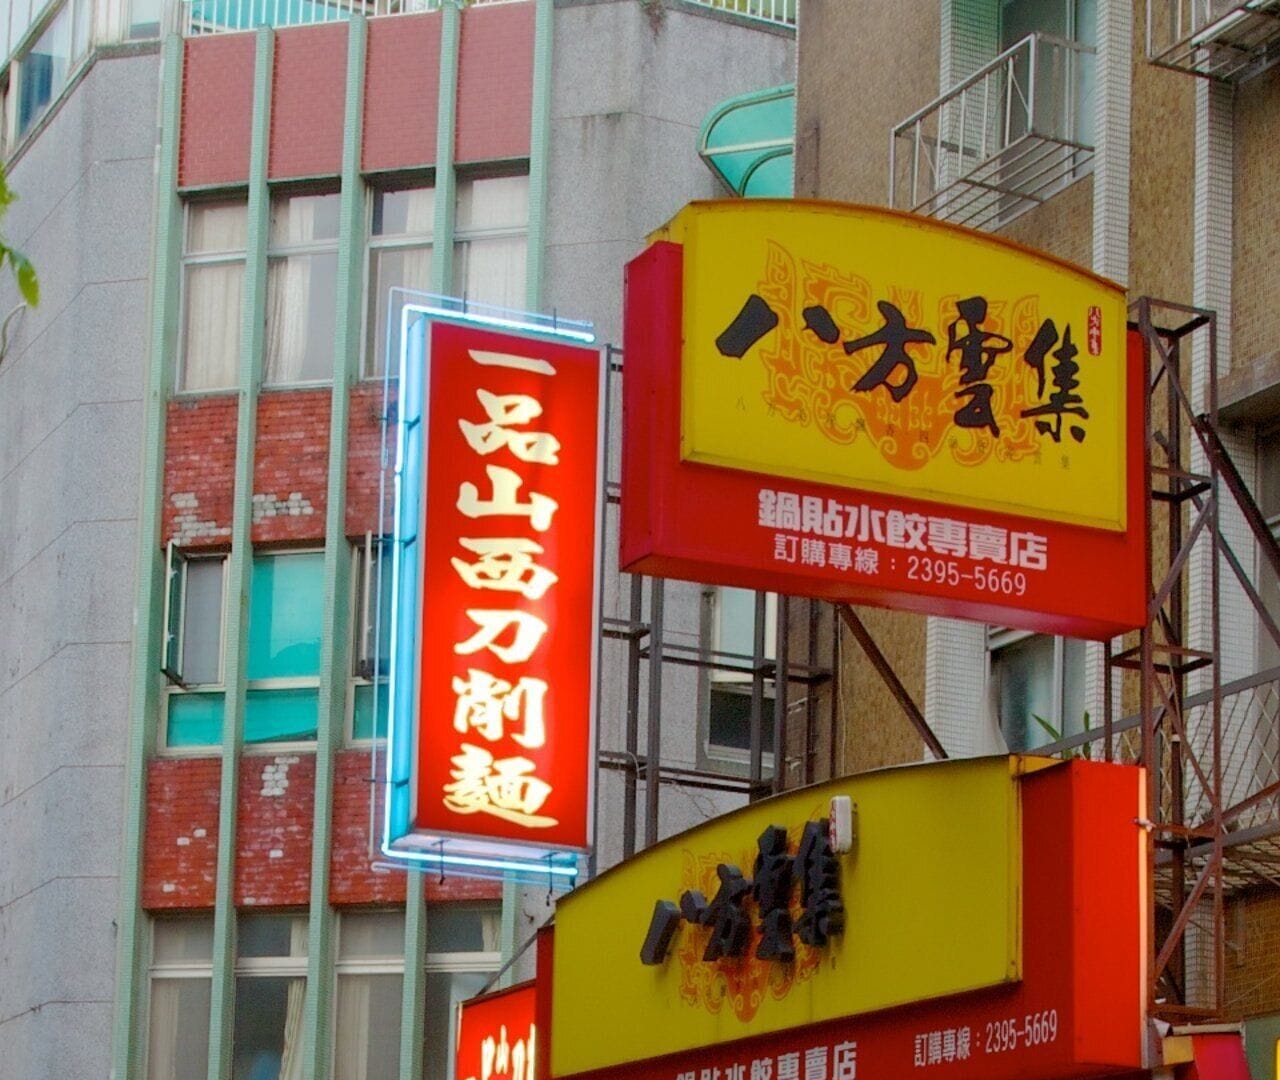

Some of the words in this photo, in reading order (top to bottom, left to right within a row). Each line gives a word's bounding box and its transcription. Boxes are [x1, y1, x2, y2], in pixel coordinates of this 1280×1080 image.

[716, 293, 1092, 443] 八方雲集
[758, 488, 1048, 571] 鍋貼水餃專賣店
[442, 347, 560, 829] 一品山西刀削麵
[907, 555, 1027, 596] 2395-5669
[985, 1009, 1058, 1054] 2395-5669
